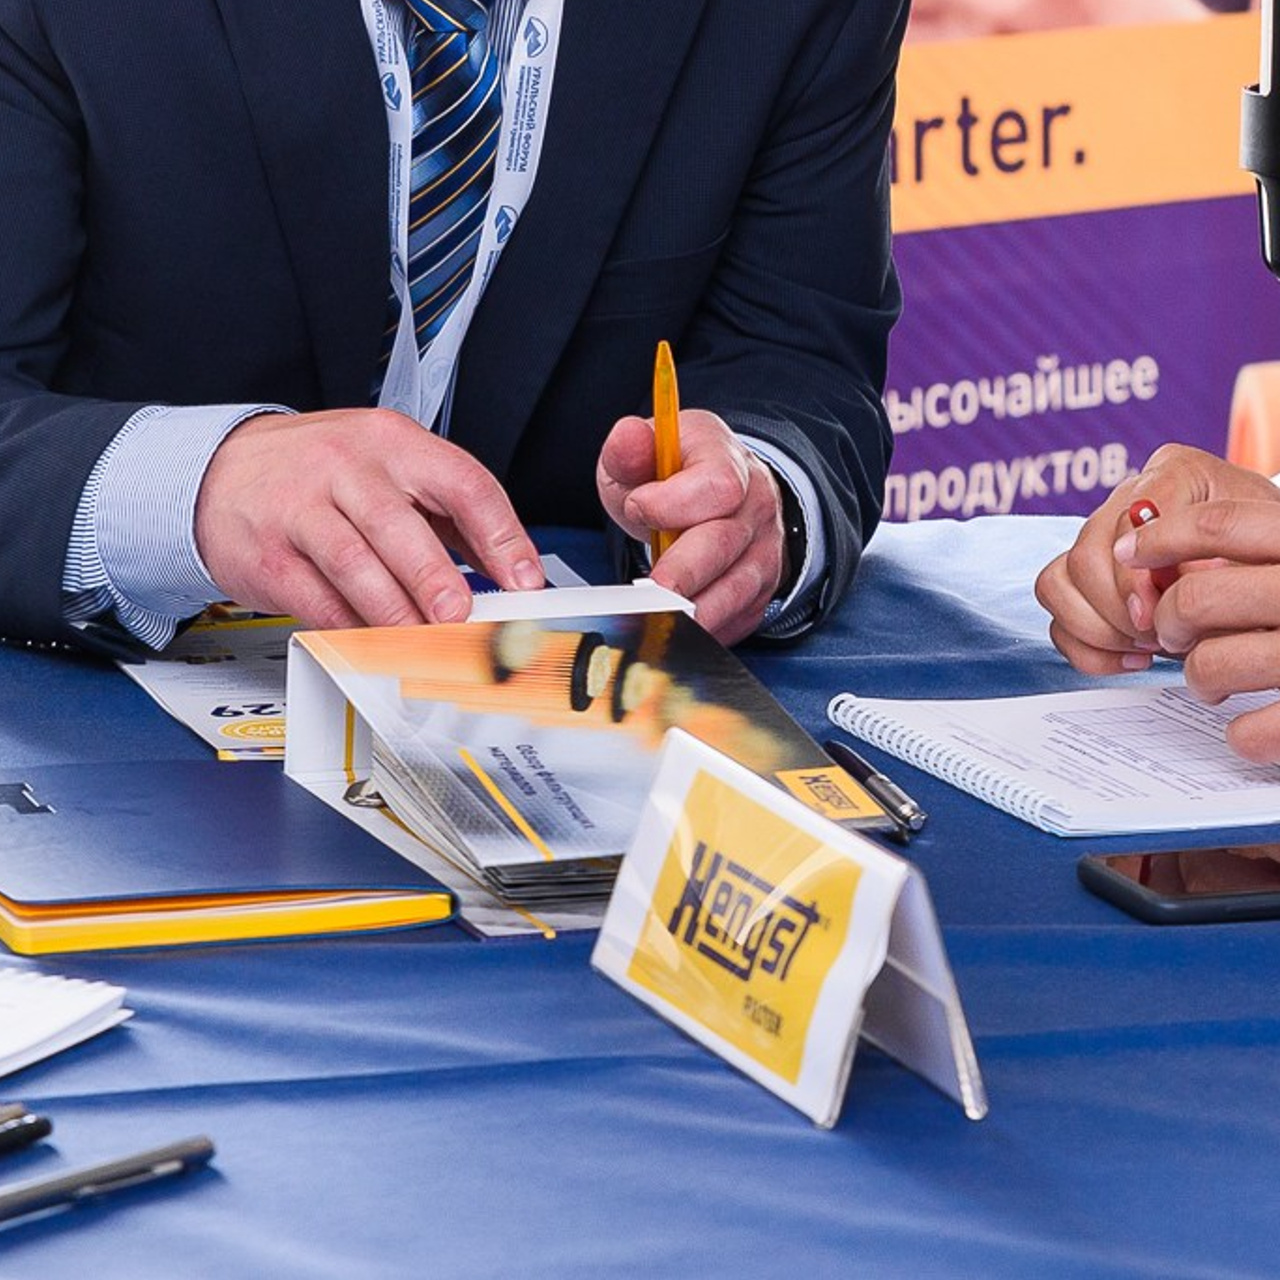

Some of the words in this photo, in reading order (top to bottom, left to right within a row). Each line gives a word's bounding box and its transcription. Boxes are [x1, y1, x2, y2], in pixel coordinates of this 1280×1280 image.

[526, 66, 542, 131] УРАЛЬСКИЙ
[518, 132, 532, 173] ФОРУМ
[886, 354, 1160, 434] ысочайшее
[211, 703, 286, 718] 29
[668, 841, 820, 982] Hengst
